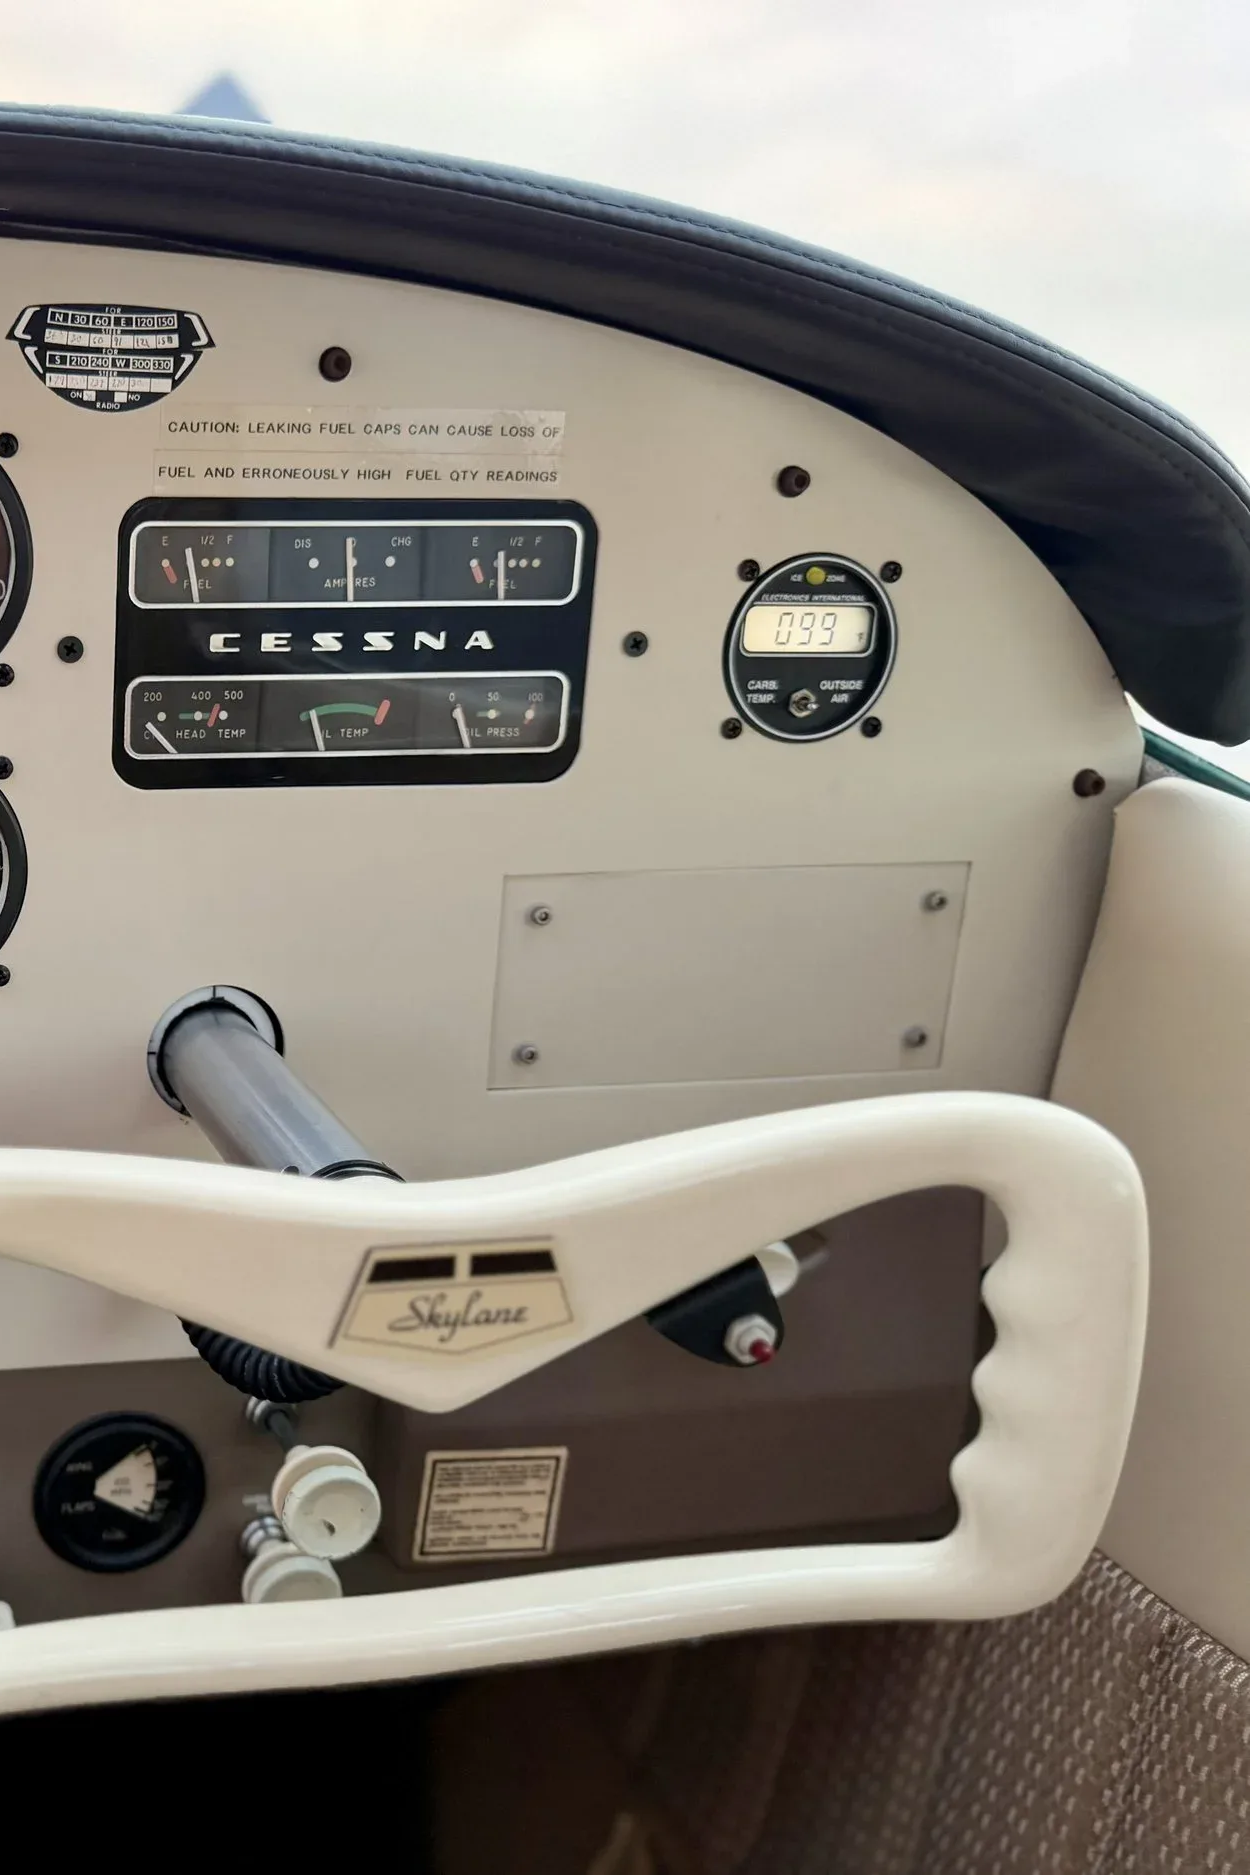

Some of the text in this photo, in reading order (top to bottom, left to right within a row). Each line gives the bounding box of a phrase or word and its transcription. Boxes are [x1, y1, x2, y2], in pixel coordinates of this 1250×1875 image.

[137, 318, 174, 327] 120 150
[71, 358, 170, 370] 210 300 330
[96, 402, 121, 410] RADIO
[168, 422, 561, 438] CAUTION: LEAKING FUEL CAPS CAN CAUSE LOSS OF
[158, 467, 558, 482] FUEL AND ERRONEOUSLY HIGH FUEL QTY READINGS
[774, 612, 837, 645] 099
[209, 630, 495, 653] CESSNA
[819, 680, 864, 690] OUTSIDE
[191, 691, 211, 700] 400
[224, 690, 244, 700] 500
[830, 694, 849, 703] AIR
[176, 728, 246, 739] HEAD TEMP
[486, 727, 519, 737] PRESS
[387, 1290, 530, 1343] Skylane
